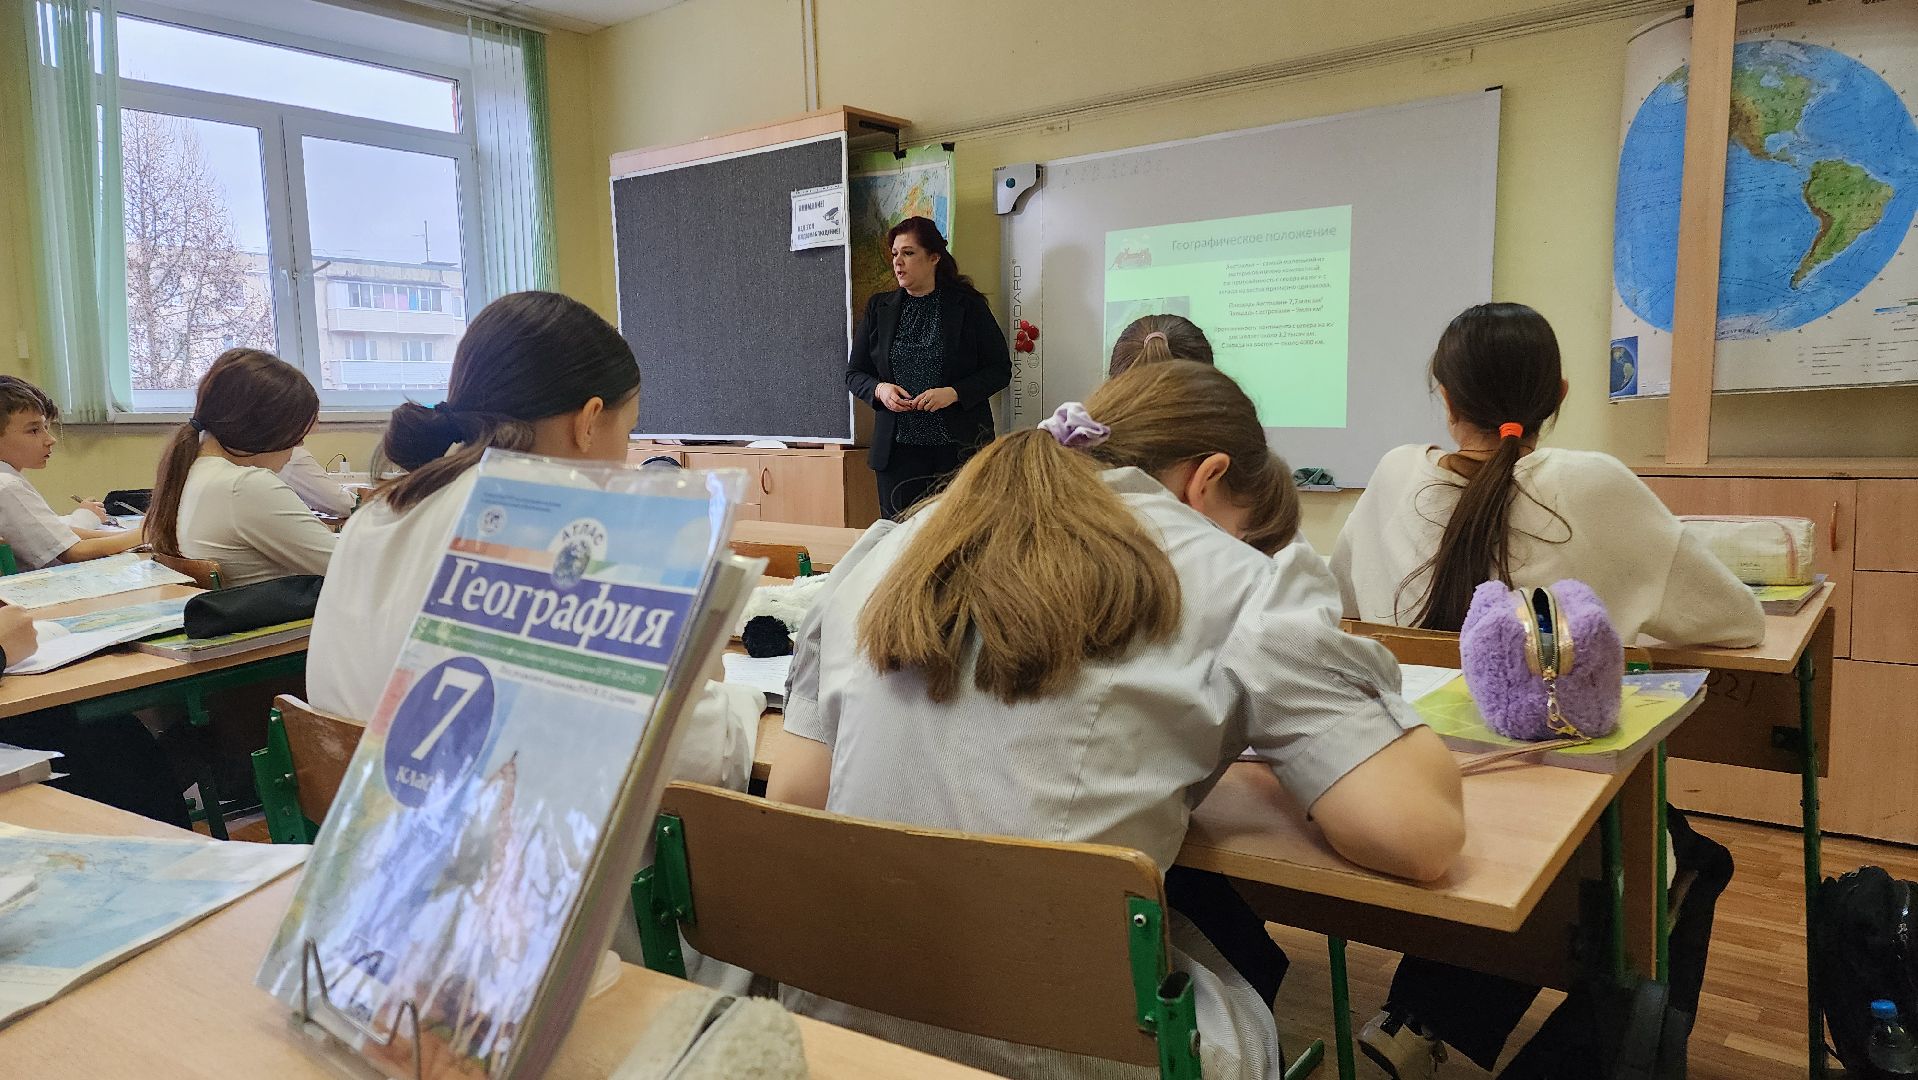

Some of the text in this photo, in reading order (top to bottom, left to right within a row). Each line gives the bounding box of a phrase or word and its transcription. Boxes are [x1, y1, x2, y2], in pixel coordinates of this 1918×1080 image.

[1172, 226, 1337, 252] Географическое положение
[562, 523, 604, 547] АТЛАС
[437, 557, 676, 650] География
[410, 665, 486, 761] 7
